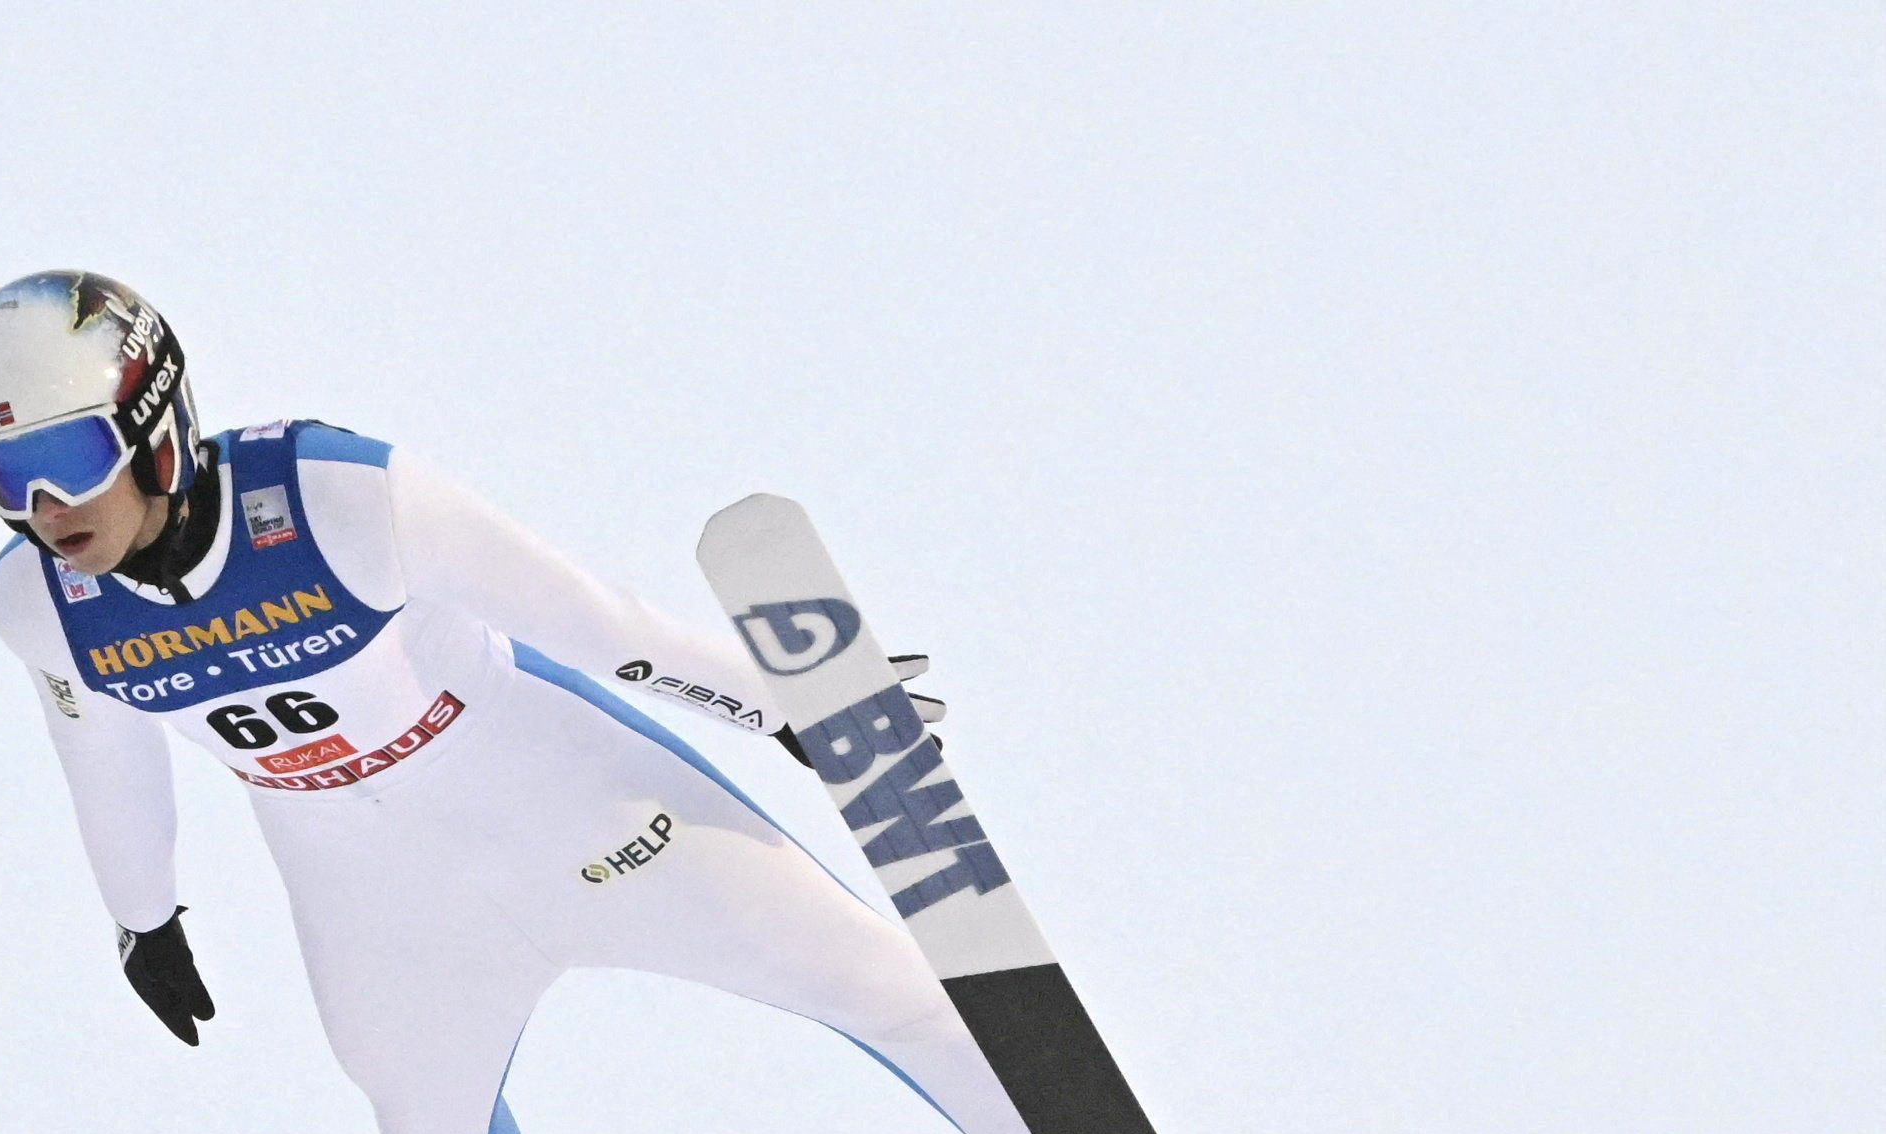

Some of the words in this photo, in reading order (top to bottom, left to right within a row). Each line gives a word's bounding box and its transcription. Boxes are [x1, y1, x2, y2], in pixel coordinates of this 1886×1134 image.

[122, 307, 155, 360] uvex
[131, 353, 178, 426] uvex
[89, 584, 333, 676] HÖRMANN
[106, 672, 195, 703] Tore
[228, 623, 357, 673] Türen
[206, 691, 340, 750] 66
[651, 676, 762, 728] FIBRA
[247, 700, 455, 791] AUHAUS
[796, 682, 1012, 920] BWT
[605, 813, 673, 876] HELP
